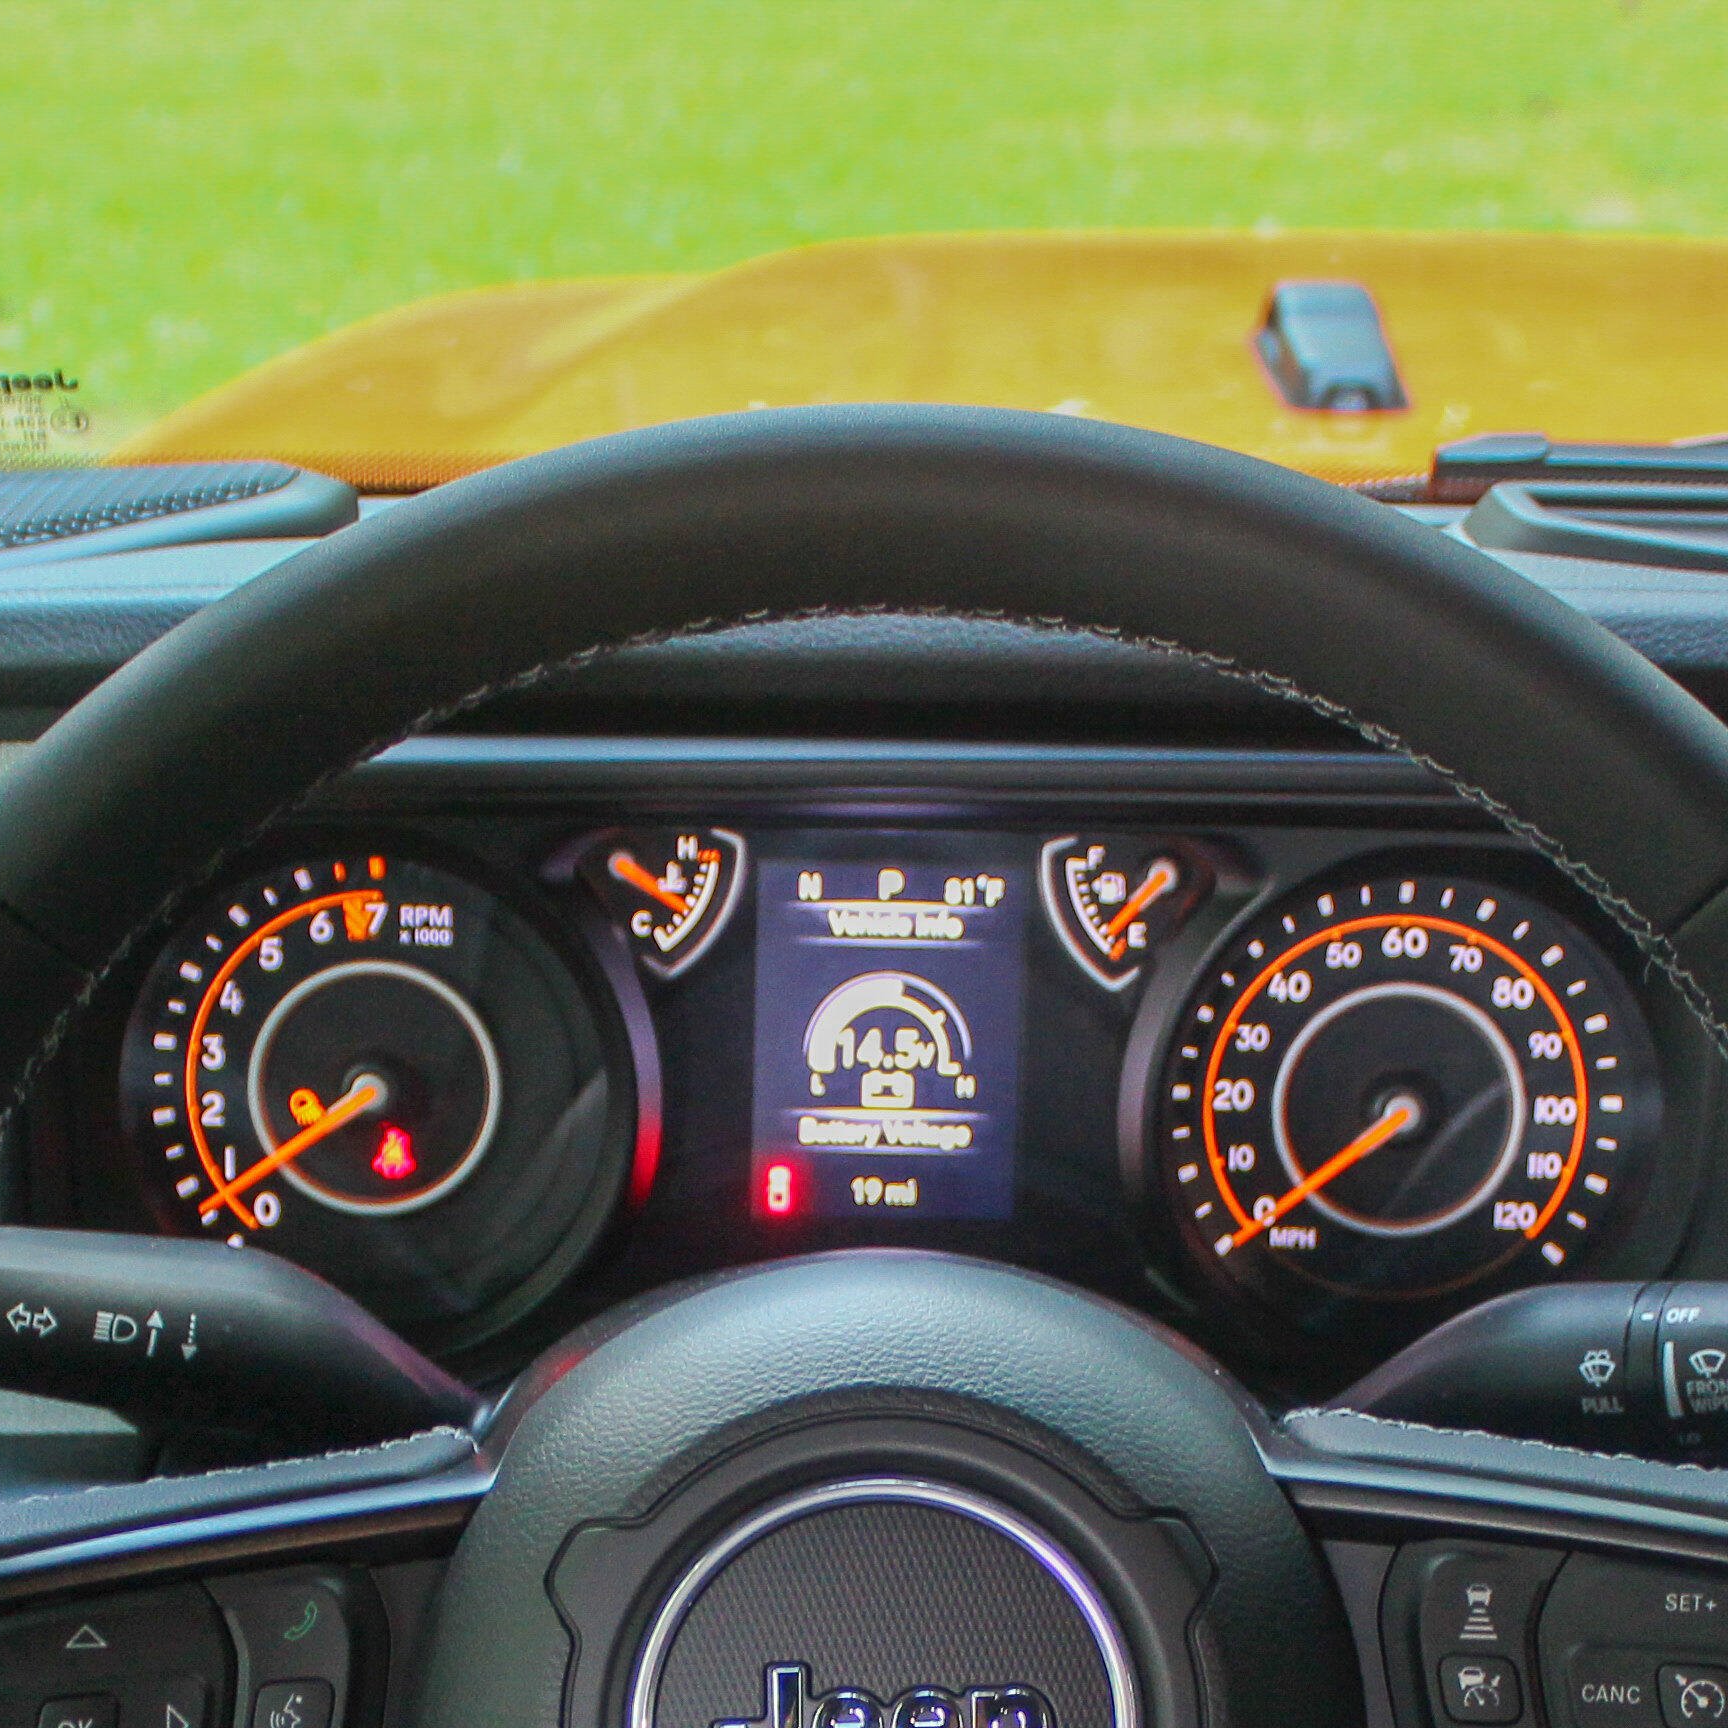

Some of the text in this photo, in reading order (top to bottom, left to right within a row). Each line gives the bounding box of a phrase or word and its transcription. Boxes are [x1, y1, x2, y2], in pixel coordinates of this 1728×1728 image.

[677, 835, 698, 861] H
[878, 867, 907, 901] P
[309, 911, 334, 944] 6
[364, 903, 389, 935] 7
[399, 904, 454, 928] RPM
[631, 910, 654, 938] C
[413, 928, 454, 946] 1000
[1127, 922, 1147, 948] E
[1381, 926, 1429, 958] 60
[259, 937, 284, 970] 5
[1325, 942, 1363, 968] 50
[1449, 944, 1483, 973] 70
[219, 981, 245, 1014] 4
[1268, 970, 1312, 1003] 40
[1491, 976, 1535, 1009] 80
[201, 1035, 226, 1070] 3
[1235, 1024, 1271, 1052] 30
[1528, 1031, 1564, 1060] 90
[201, 1091, 226, 1126] 2
[1213, 1079, 1254, 1112] 20
[1533, 1096, 1577, 1125] 100
[224, 1145, 236, 1181] 1
[1228, 1144, 1255, 1172] 10
[1527, 1151, 1563, 1180] 110
[850, 1175, 885, 1206] 19
[253, 1191, 282, 1227] 0
[1493, 1202, 1538, 1231] 120
[1269, 1227, 1317, 1249] MPH
[1666, 1306, 1701, 1324] OFF
[1581, 1397, 1623, 1414] PULL
[1580, 1684, 1641, 1704] CANC
